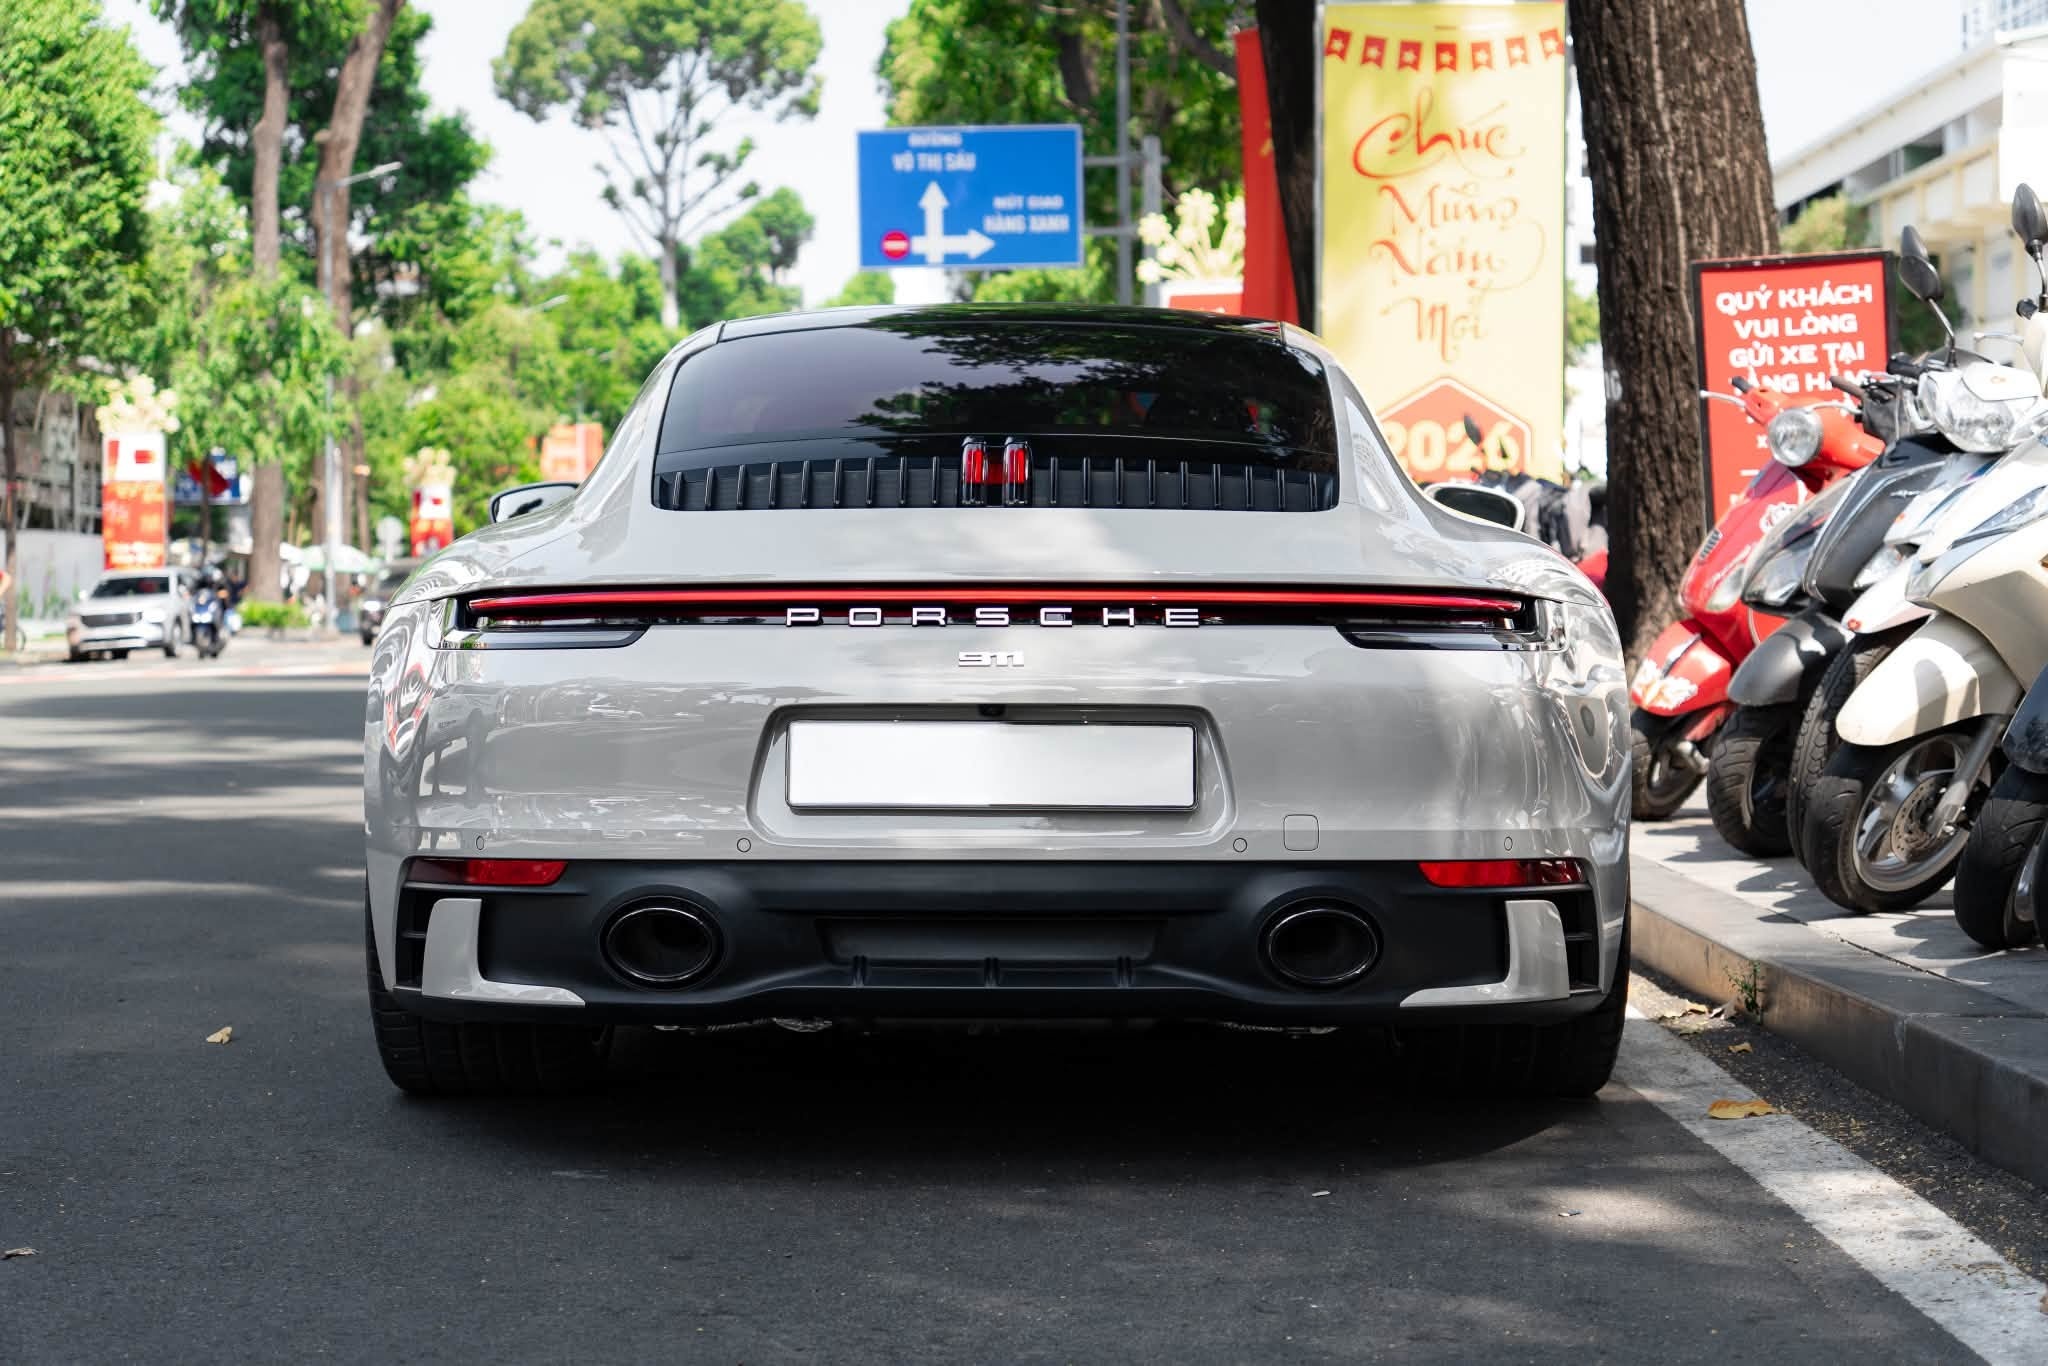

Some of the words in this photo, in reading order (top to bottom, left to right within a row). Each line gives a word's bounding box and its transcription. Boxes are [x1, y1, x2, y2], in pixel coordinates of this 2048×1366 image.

[1353, 87, 1525, 178] Chúc
[1716, 284, 1773, 315] QUÝ
[1778, 280, 1873, 308] KHÁCH
[1734, 317, 1779, 339] VUI
[1785, 310, 1858, 337] LÒNG
[1729, 341, 1774, 368] GỬI
[1779, 344, 1818, 366] XE
[1822, 341, 1865, 365] TẠI
[786, 607, 1200, 627] PORSCHE
[958, 650, 1025, 667] 911
